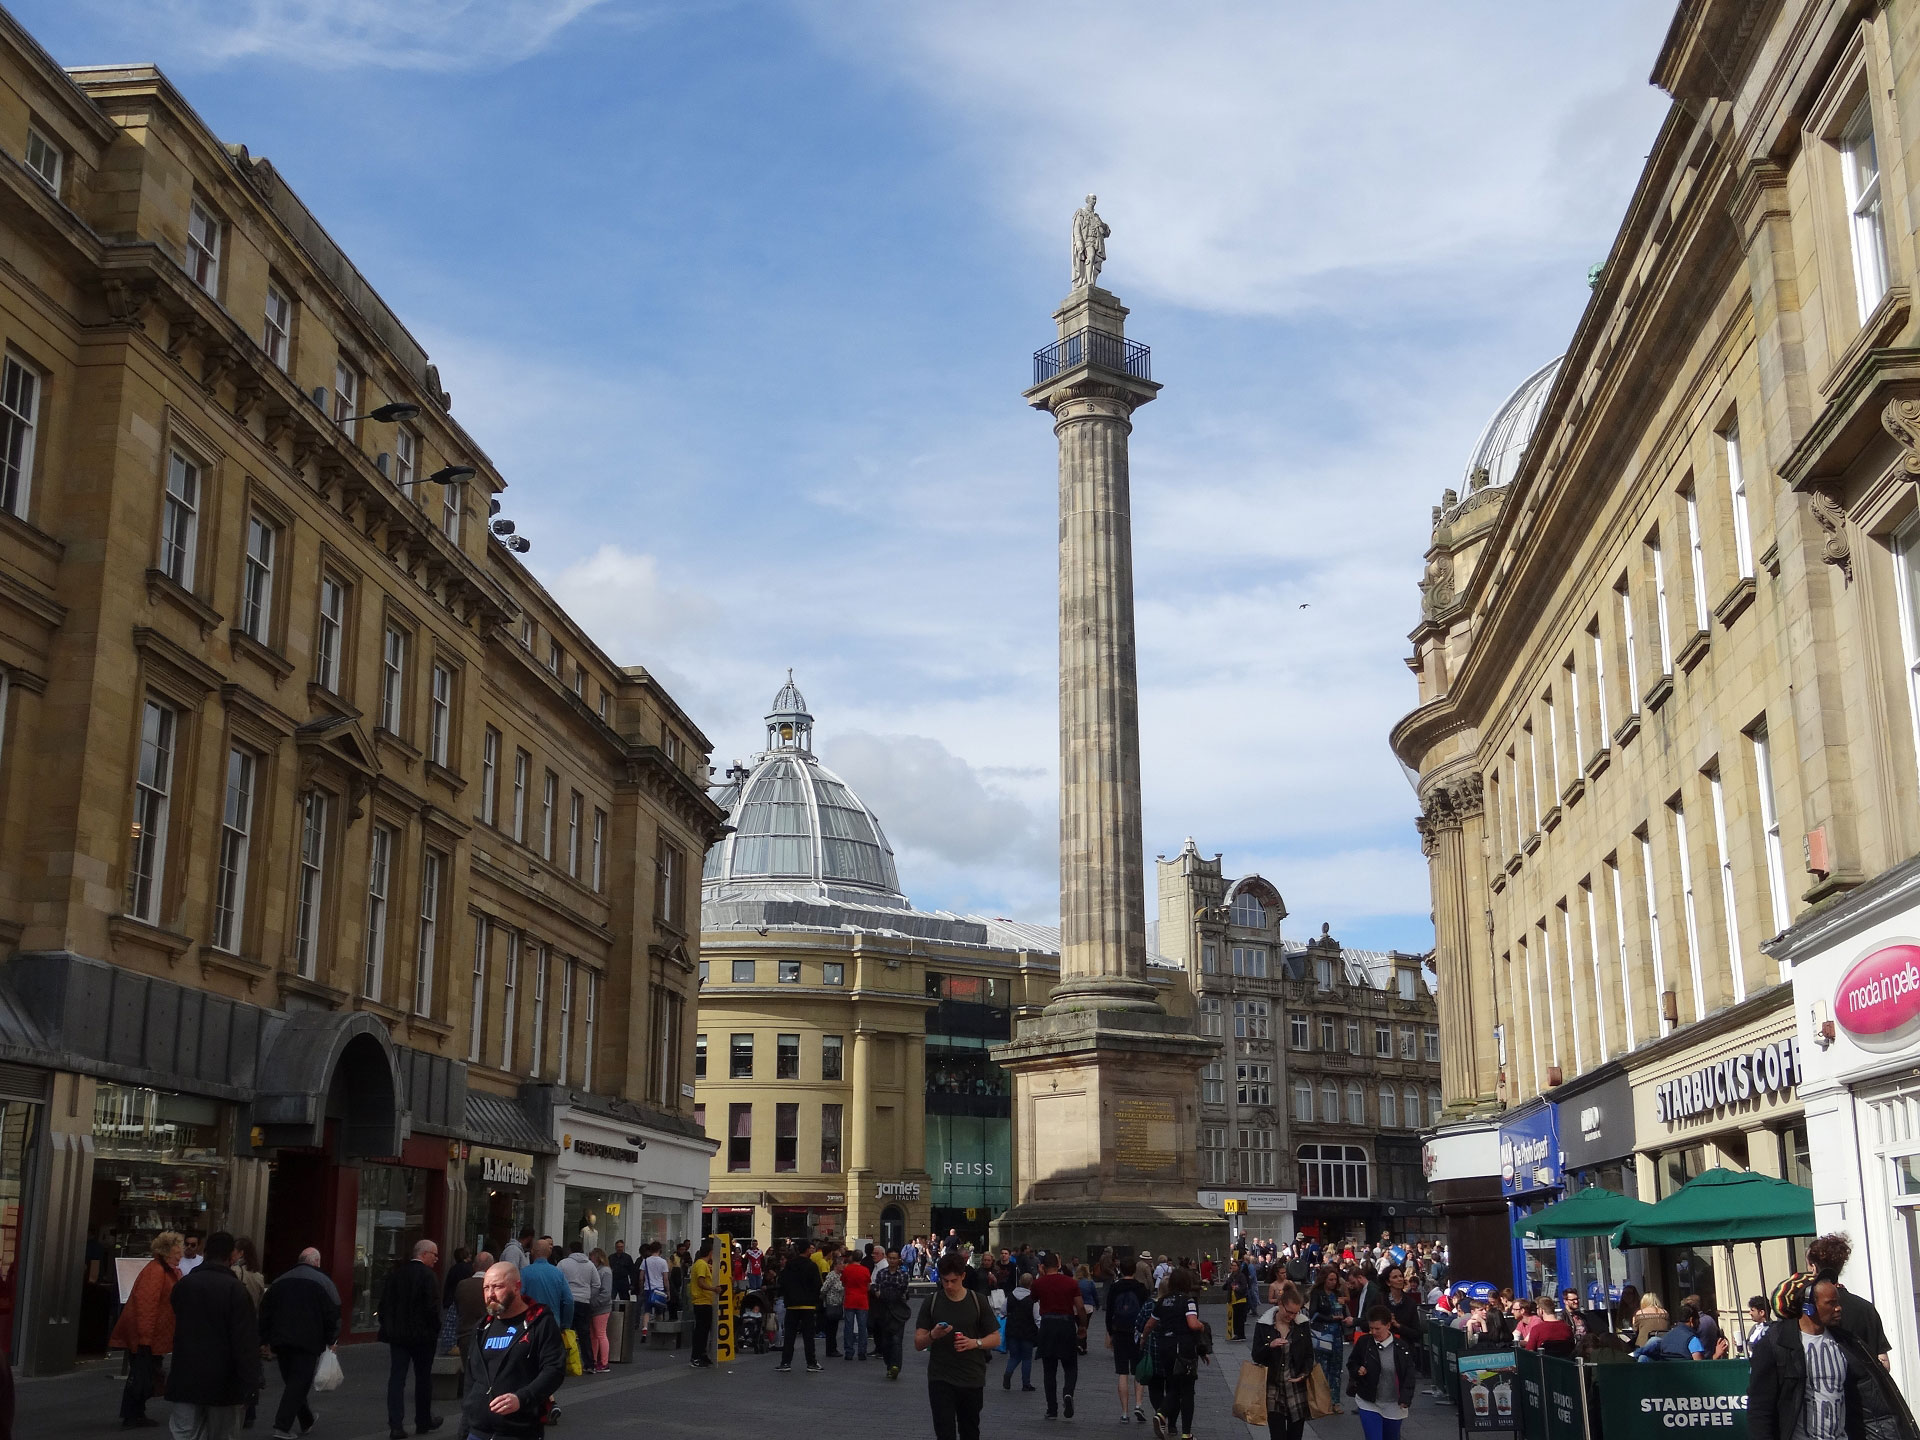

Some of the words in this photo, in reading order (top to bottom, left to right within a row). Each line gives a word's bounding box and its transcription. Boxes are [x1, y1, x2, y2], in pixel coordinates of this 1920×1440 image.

[1849, 976, 1881, 1012] moda
[1880, 972, 1892, 1000] in
[1892, 961, 1919, 1004] pelle
[1655, 1054, 1749, 1123] STARBUCKS
[494, 1159, 528, 1185] Martens
[943, 1162, 993, 1175] REISS
[1227, 1202, 1236, 1211] M
[717, 1284, 732, 1357] JOHN
[1641, 1395, 1748, 1412] STARBUCKS
[1663, 1412, 1733, 1428] COFFEE
